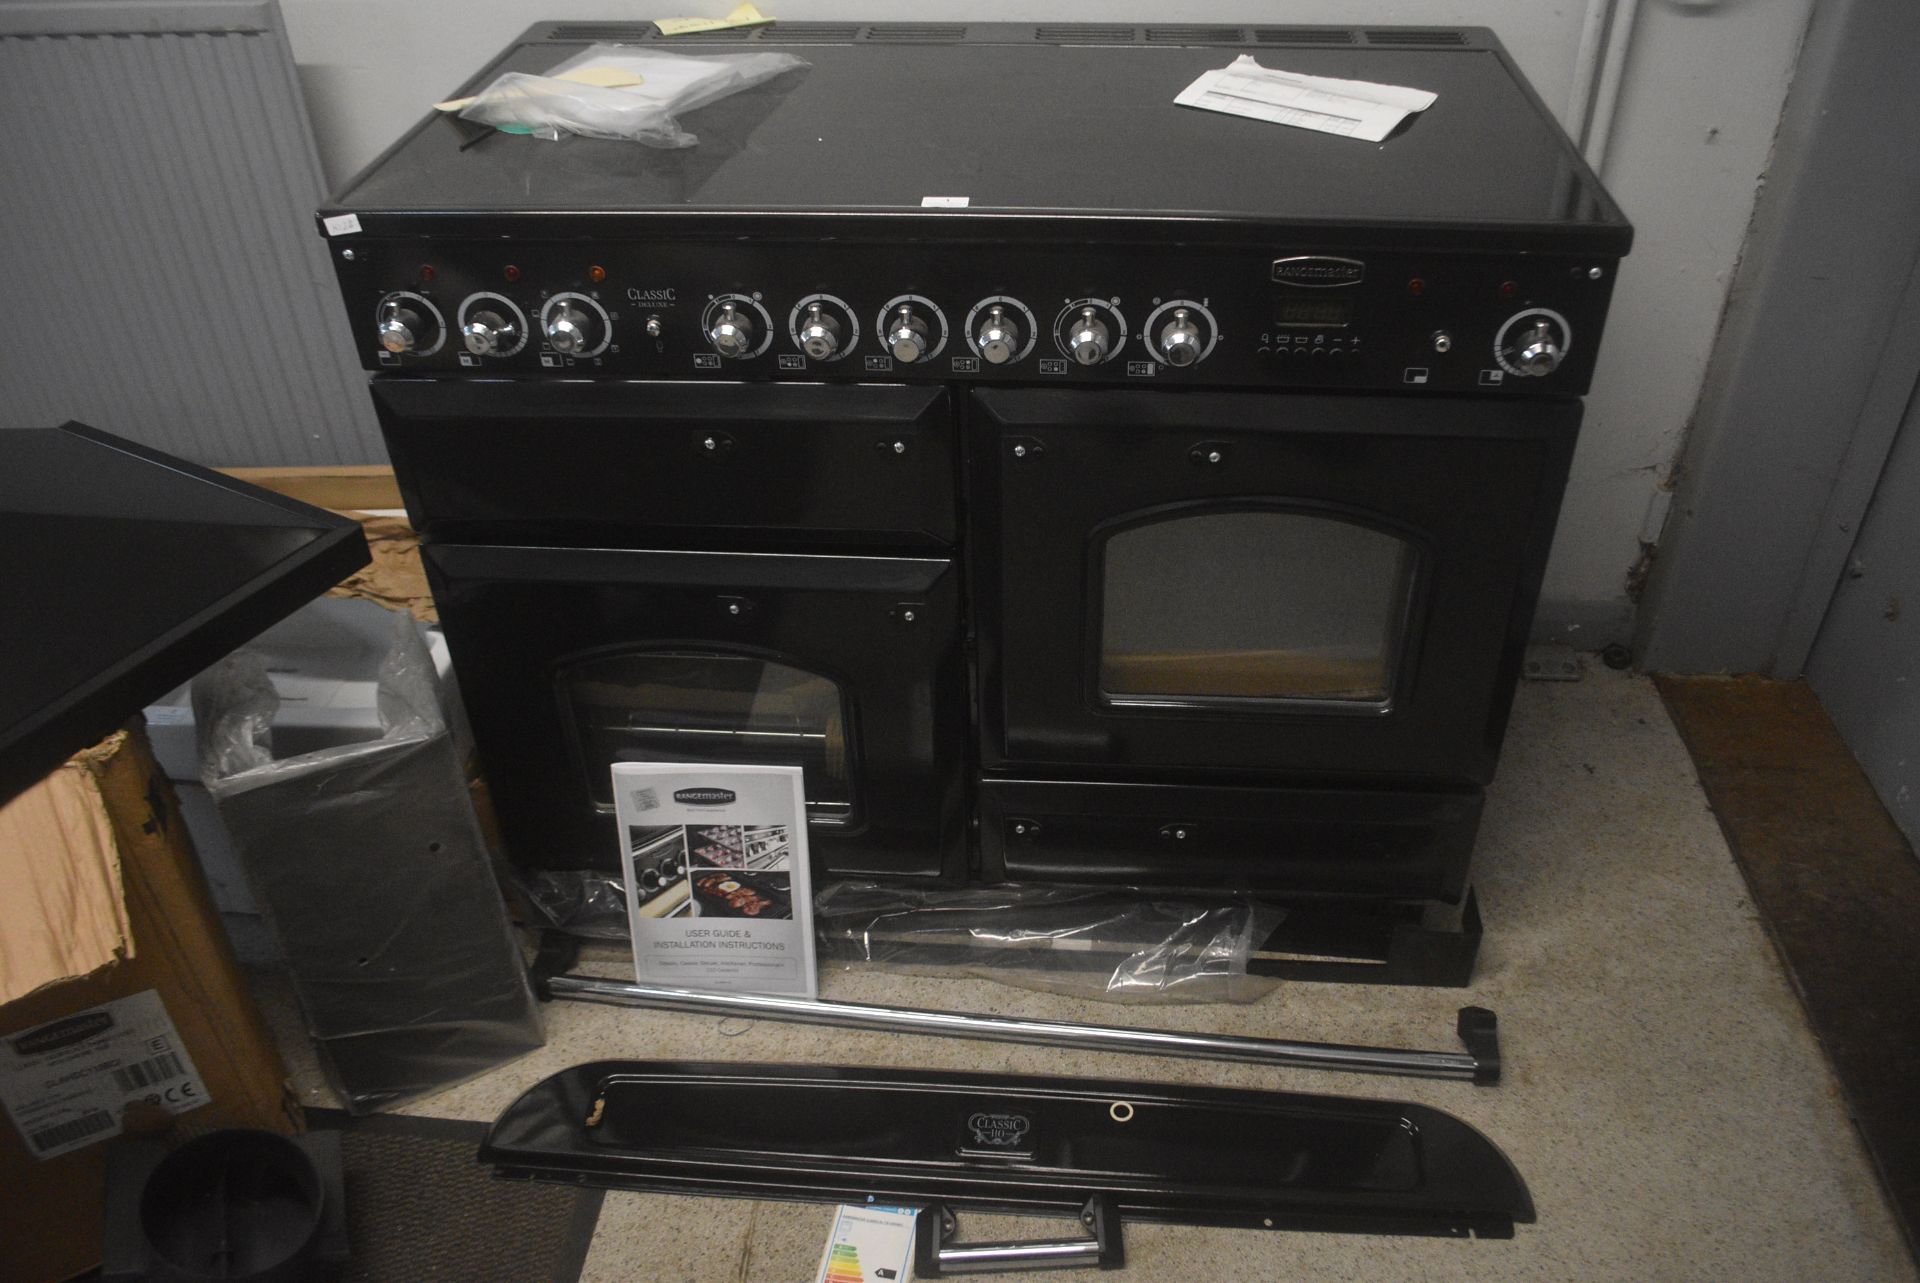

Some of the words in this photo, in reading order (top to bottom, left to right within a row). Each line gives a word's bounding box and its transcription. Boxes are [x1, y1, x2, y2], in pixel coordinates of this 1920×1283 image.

[627, 288, 676, 300] CLASSIC
[685, 930, 710, 938] USER
[713, 930, 741, 938] GUIDE
[744, 930, 752, 938] &
[653, 941, 716, 949] INSTALLATION
[719, 941, 785, 951] INSTRUCTIONS
[152, 1038, 166, 1051] E
[977, 1117, 1021, 1131] CLASSIC
